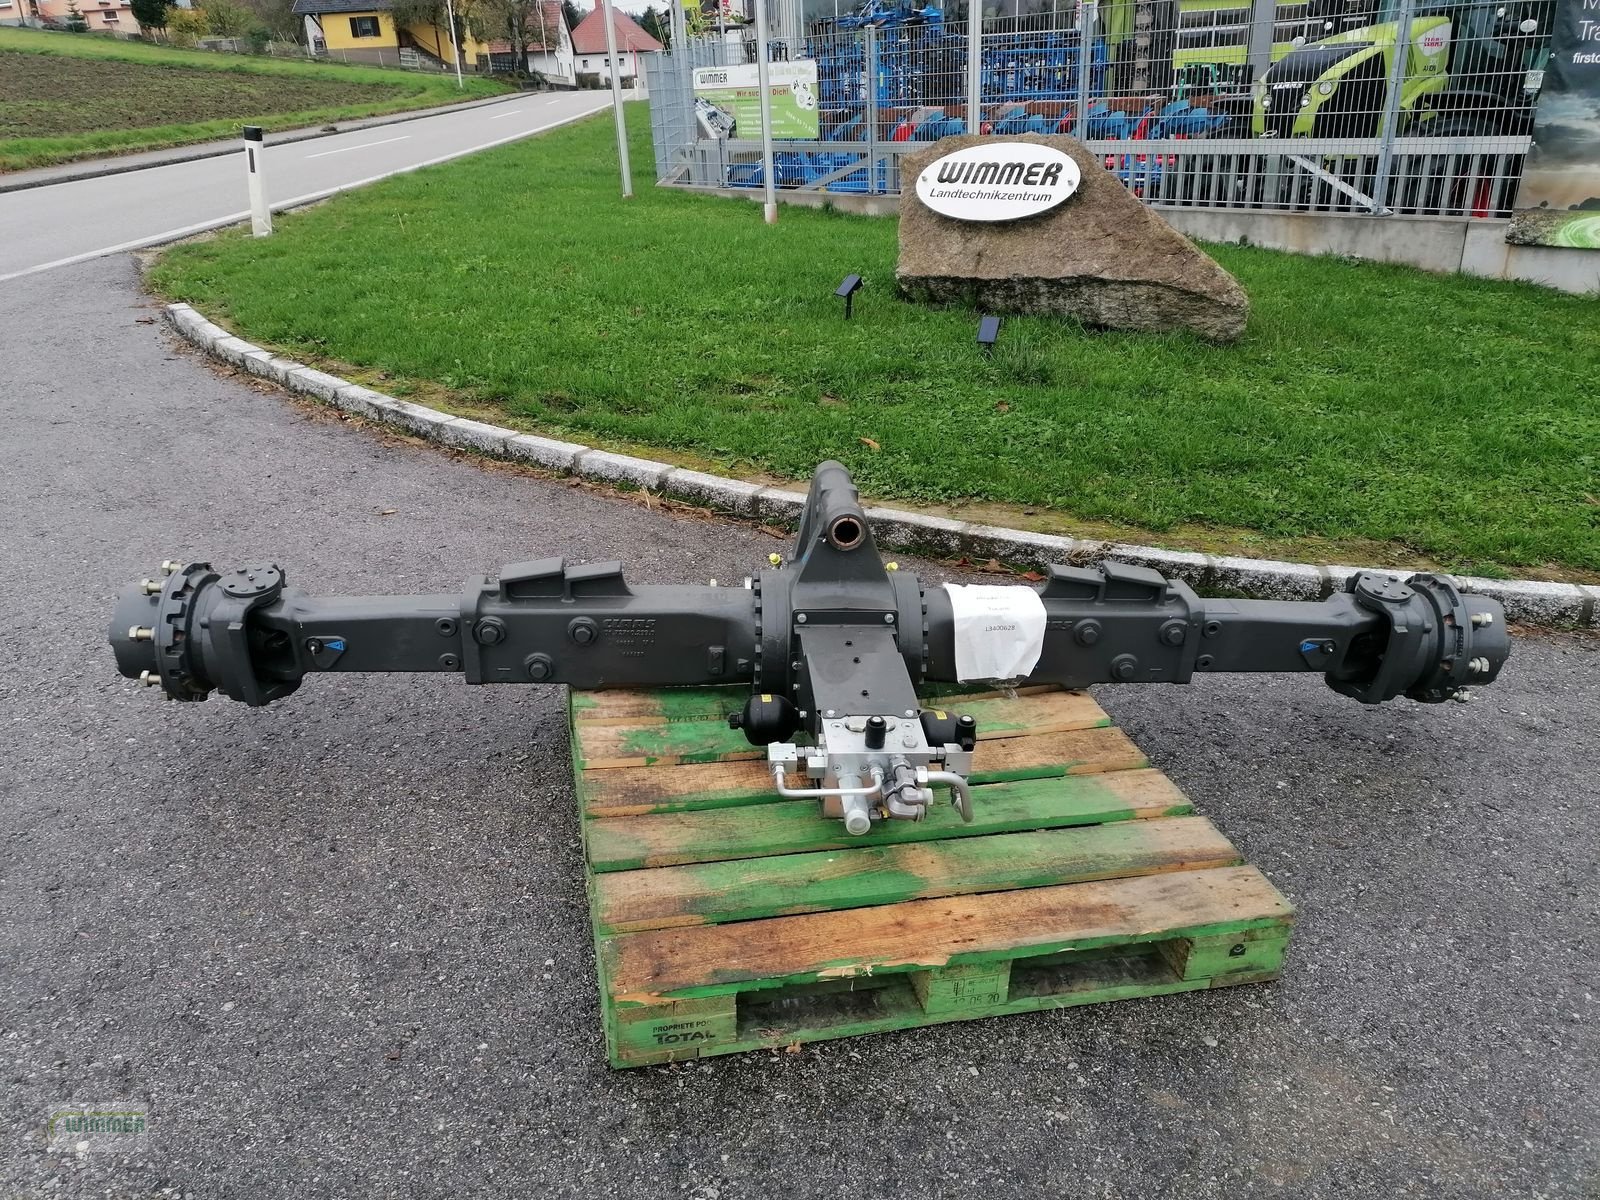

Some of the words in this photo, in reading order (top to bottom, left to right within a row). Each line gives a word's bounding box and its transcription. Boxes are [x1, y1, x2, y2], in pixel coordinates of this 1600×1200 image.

[699, 72, 728, 84] WIMMER
[772, 87, 789, 96] Dich!
[937, 161, 1064, 187] WIMMER
[929, 188, 1053, 203] Landtechnikzentrum
[652, 1022, 695, 1034] PROPRIETE
